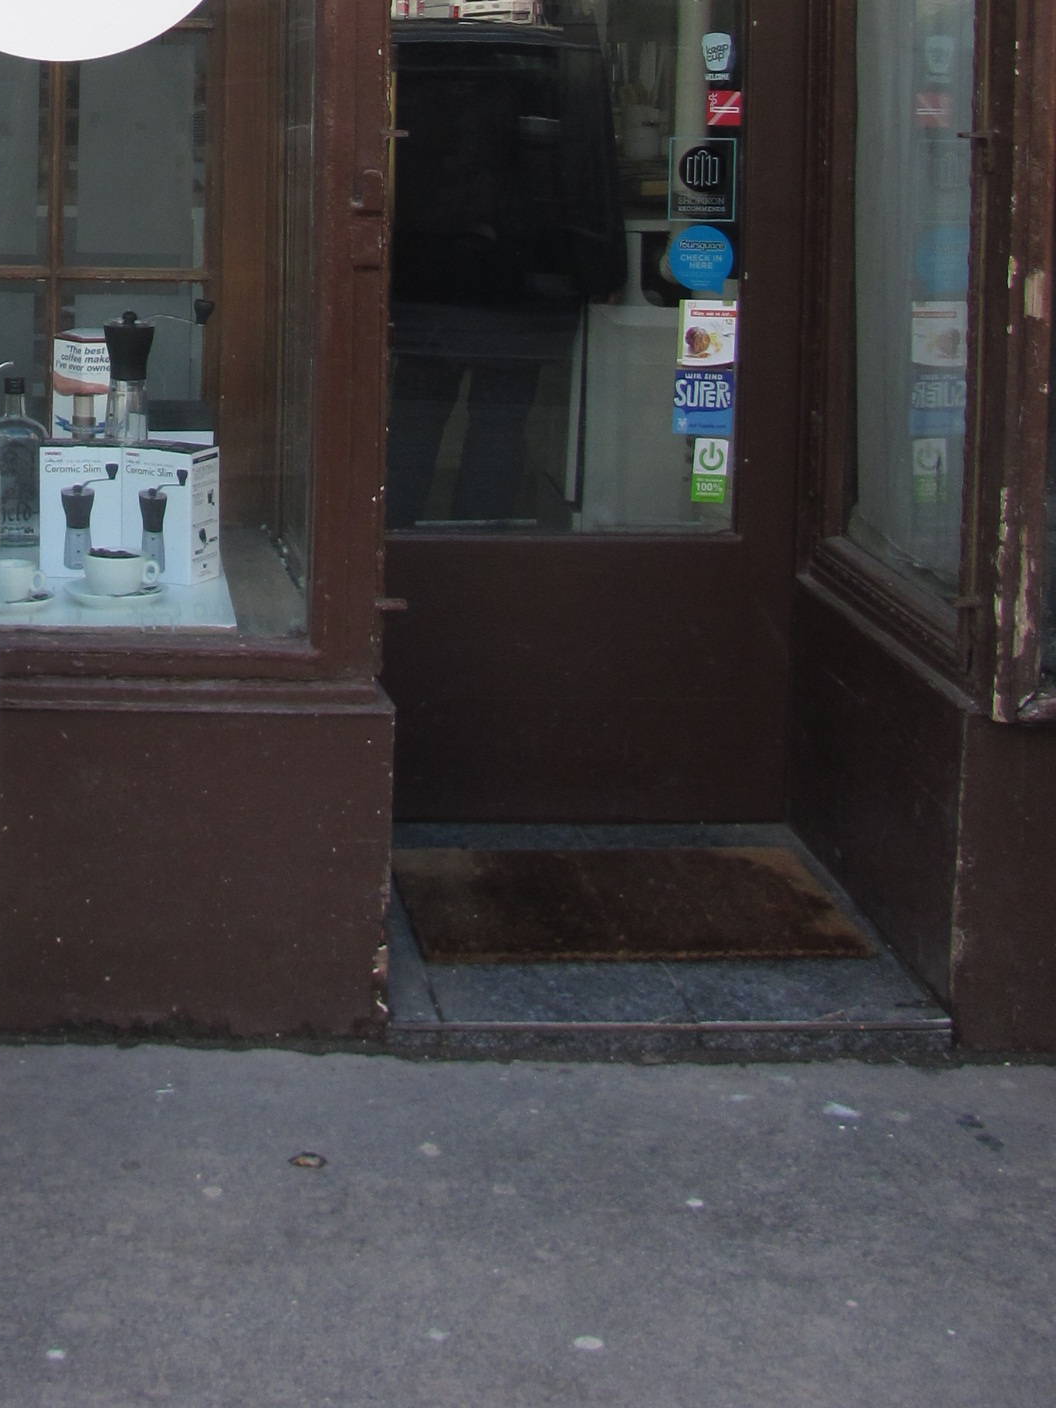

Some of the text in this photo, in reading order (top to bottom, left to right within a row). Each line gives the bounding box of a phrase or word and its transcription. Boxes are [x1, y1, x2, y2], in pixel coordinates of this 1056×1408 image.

[706, 43, 729, 54] keep
[707, 52, 725, 62] cup
[679, 240, 726, 251] foursquare
[680, 254, 711, 262] CHECK
[688, 262, 713, 270] HERE
[84, 346, 105, 355] best
[684, 372, 724, 380] WIR SIND
[673, 379, 732, 408] SUPER!
[45, 463, 102, 474] Ceramic Slim
[125, 464, 174, 478] Ceramic Slim
